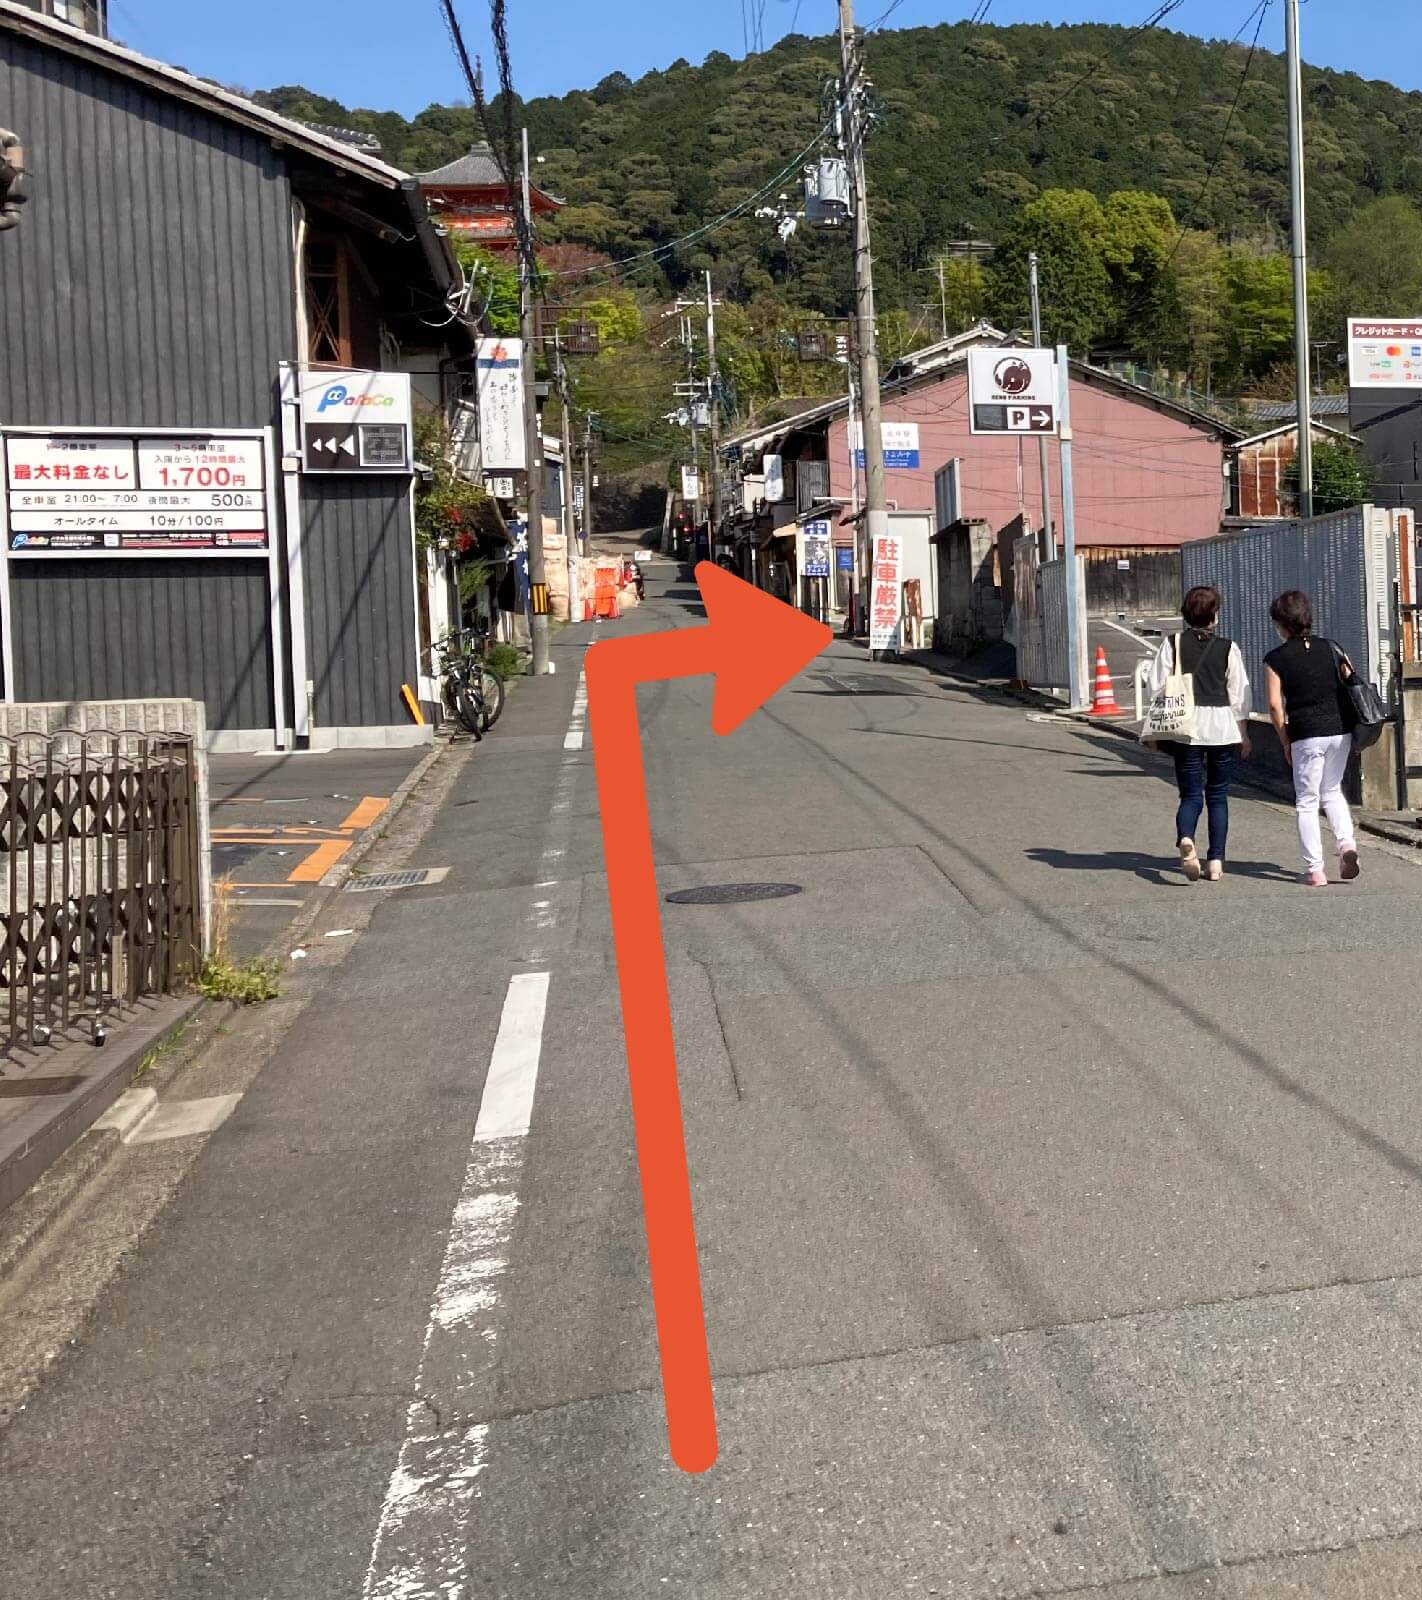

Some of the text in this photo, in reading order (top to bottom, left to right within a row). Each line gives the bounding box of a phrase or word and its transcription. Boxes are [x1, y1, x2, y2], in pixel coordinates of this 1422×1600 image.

[1012, 411, 1024, 425] P
[14, 464, 129, 480] 最大料金なし
[159, 467, 246, 486] 1,700円
[54, 517, 119, 526] オールタイム
[875, 538, 899, 629] 駐車厳禁
